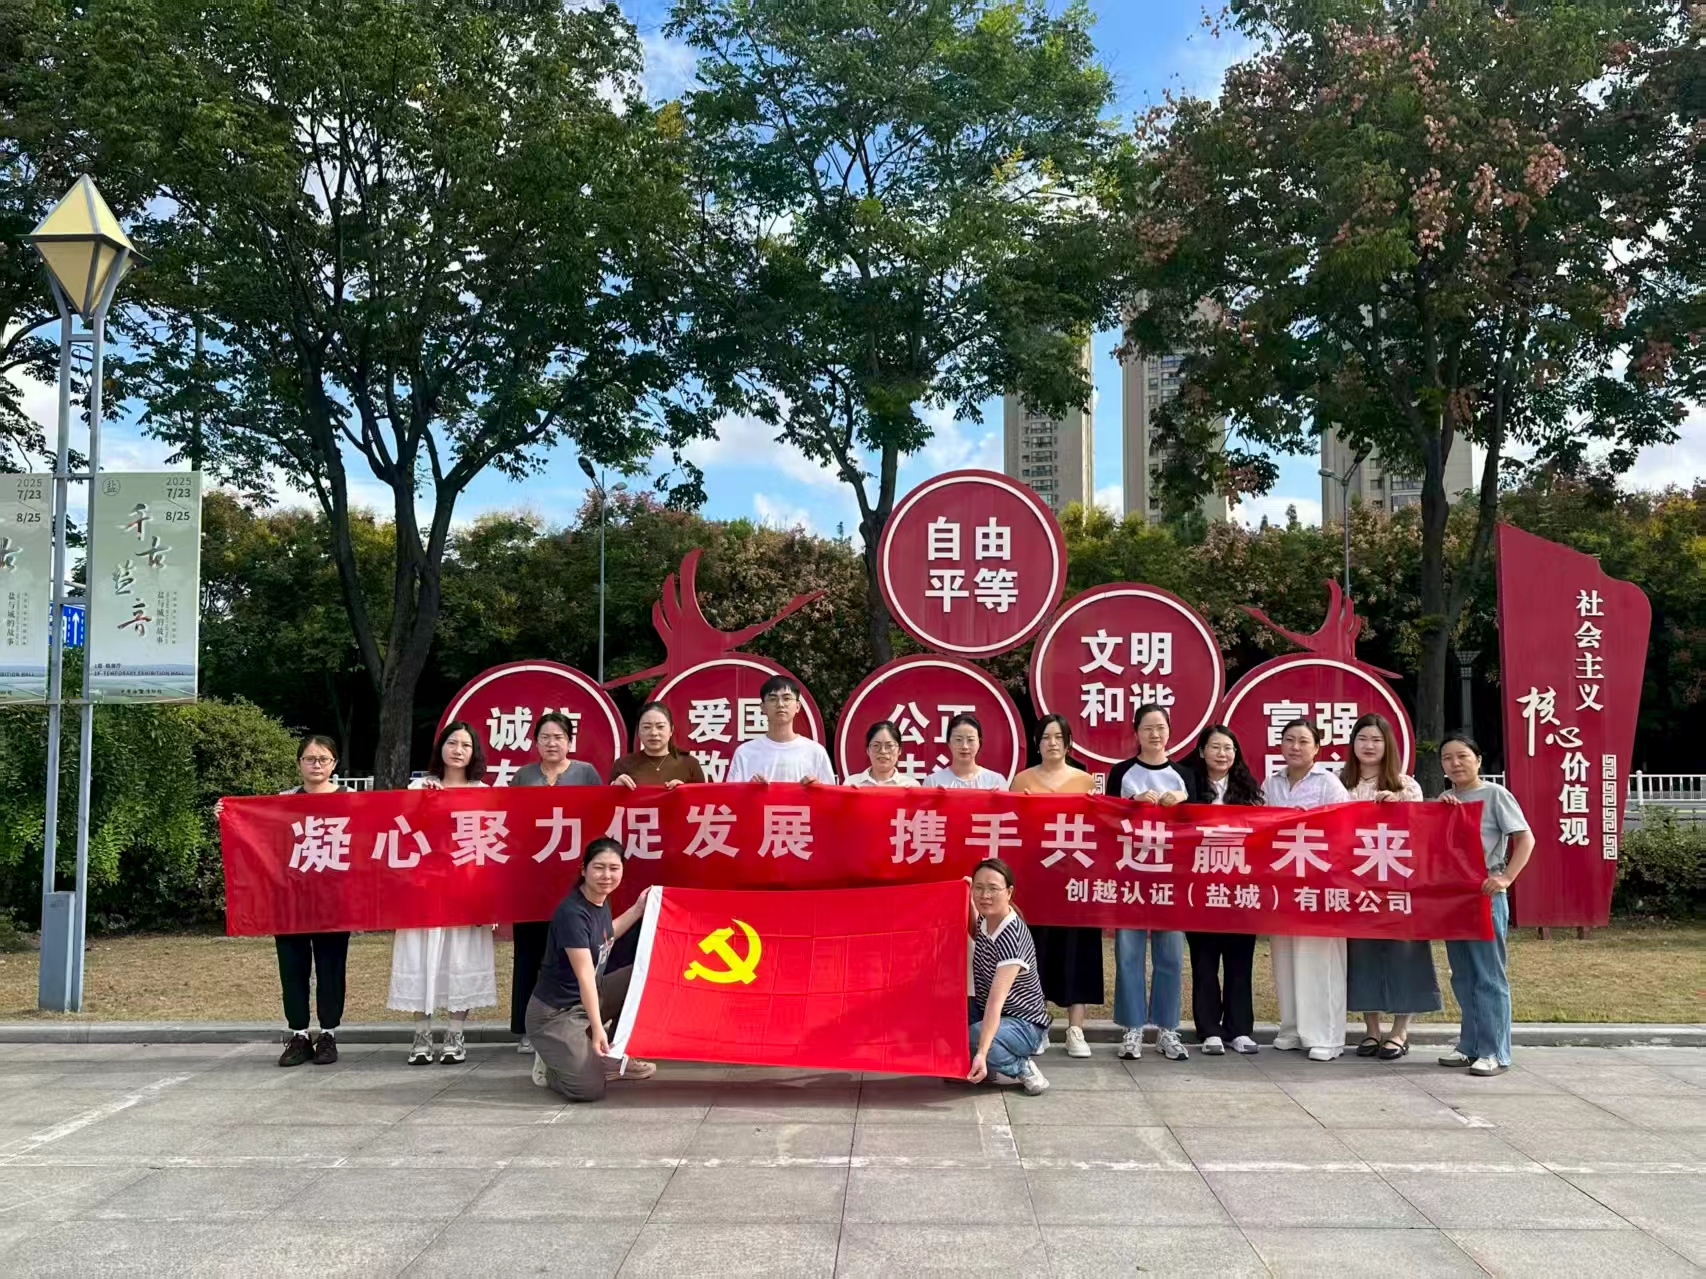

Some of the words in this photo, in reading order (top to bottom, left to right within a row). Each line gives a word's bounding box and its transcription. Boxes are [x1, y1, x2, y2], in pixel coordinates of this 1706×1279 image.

[17, 479, 42, 488] 2025
[17, 490, 41, 500] 7/23
[166, 477, 192, 486] 2025
[167, 488, 191, 499] 7/23
[16, 513, 41, 523] 8/25
[165, 511, 190, 522] 8/25
[928, 516, 1011, 560] 自由
[925, 568, 1018, 612] 平等
[1079, 629, 1172, 675] 文明
[1574, 589, 1604, 711] 社会主义
[688, 698, 768, 743] 爱国
[1263, 699, 1358, 746] 富强
[288, 803, 814, 873] 凝心聚力促发展
[889, 809, 1414, 881] 携手共进赢未来
